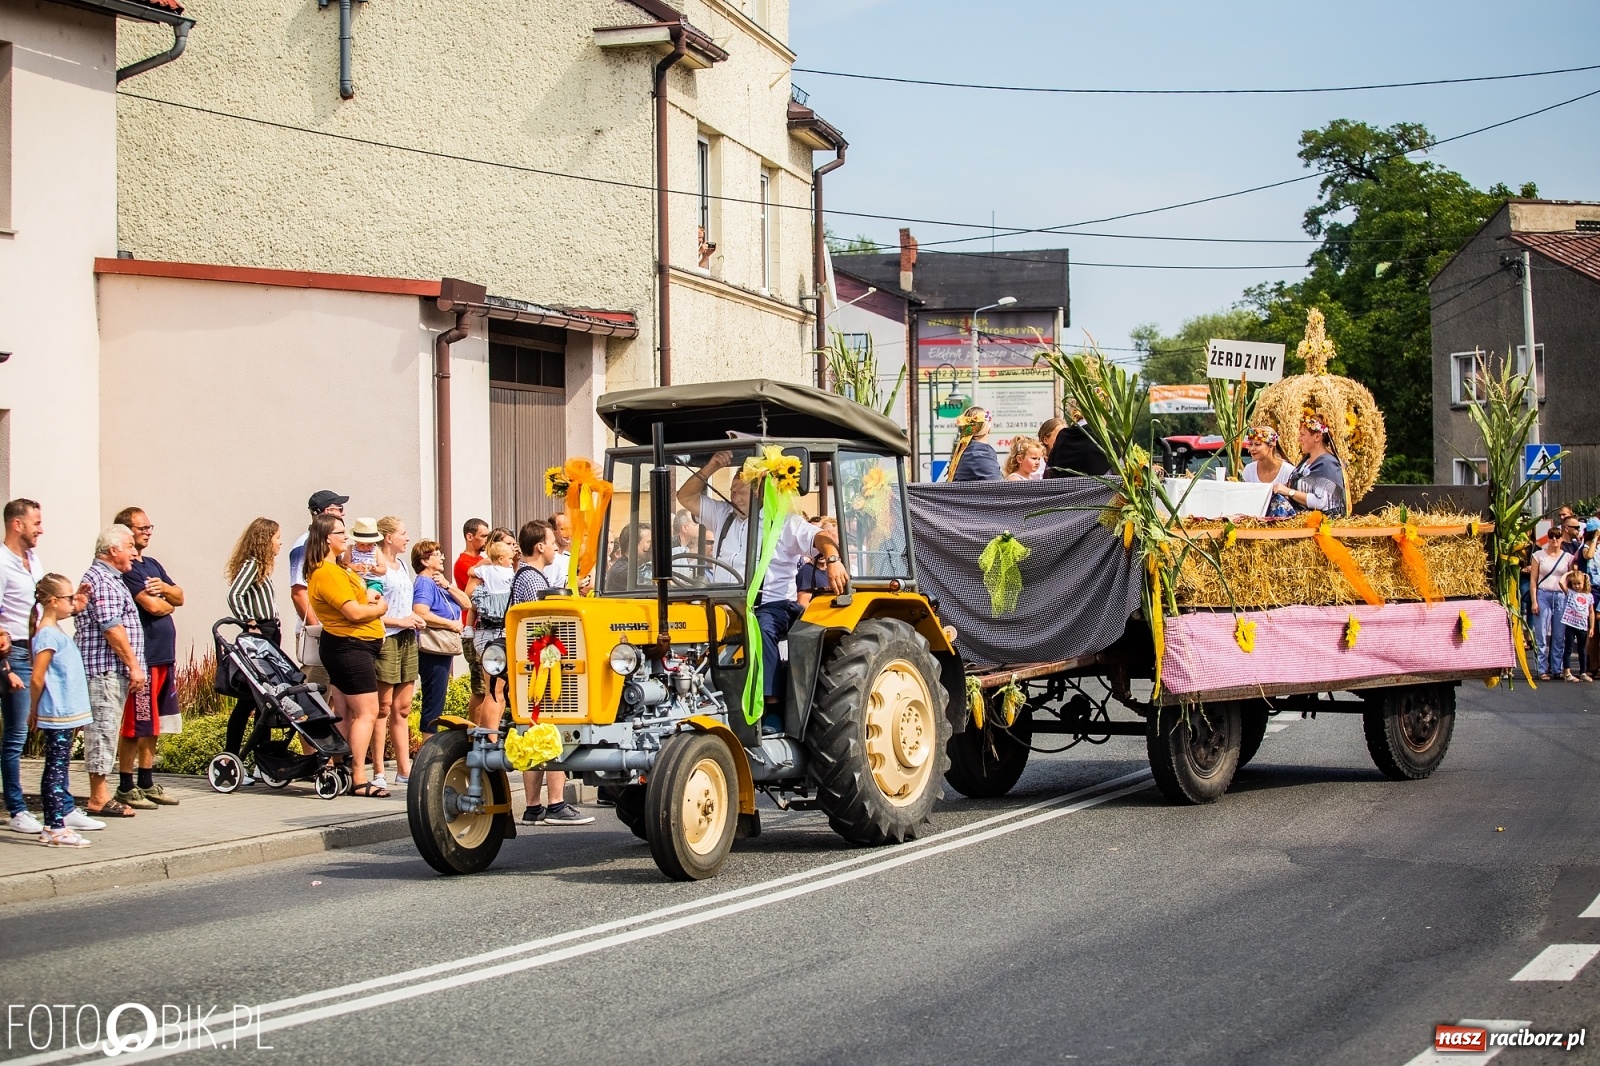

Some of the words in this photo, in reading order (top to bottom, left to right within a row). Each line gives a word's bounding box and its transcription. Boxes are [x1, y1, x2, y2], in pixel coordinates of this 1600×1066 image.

[927, 318, 989, 327] WAWRZNEK
[1210, 345, 1277, 371] ŻERDZINY
[610, 622, 650, 631] URSUS
